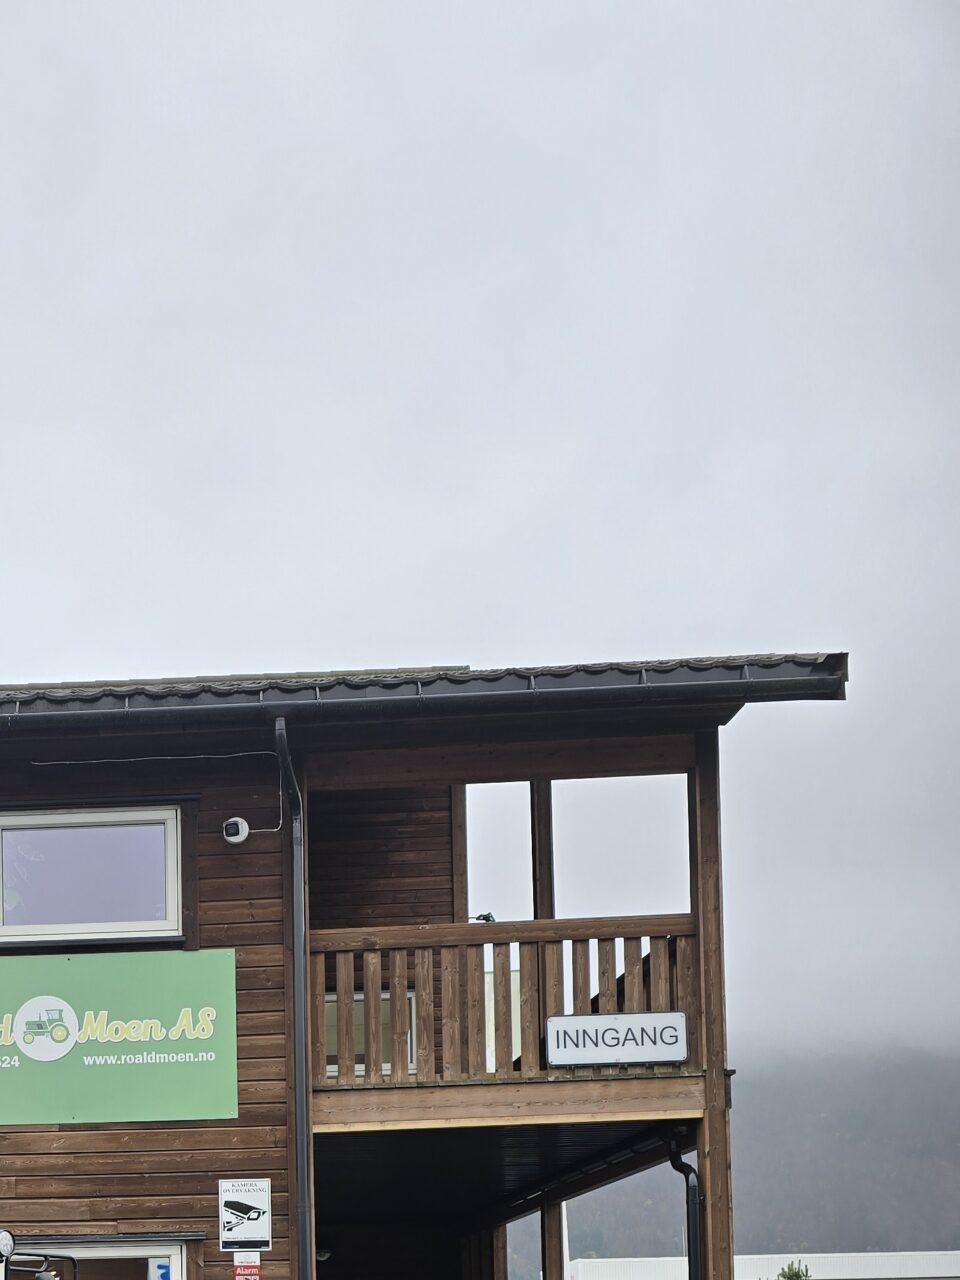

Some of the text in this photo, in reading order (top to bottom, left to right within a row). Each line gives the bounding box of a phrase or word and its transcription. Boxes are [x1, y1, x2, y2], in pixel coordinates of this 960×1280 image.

[76, 1010, 166, 1043] Moen
[169, 1007, 216, 1040] AS
[556, 1026, 678, 1049] INNGANG
[83, 1051, 216, 1065] www.roaldmoen.no
[236, 1266, 259, 1275] Alarm
